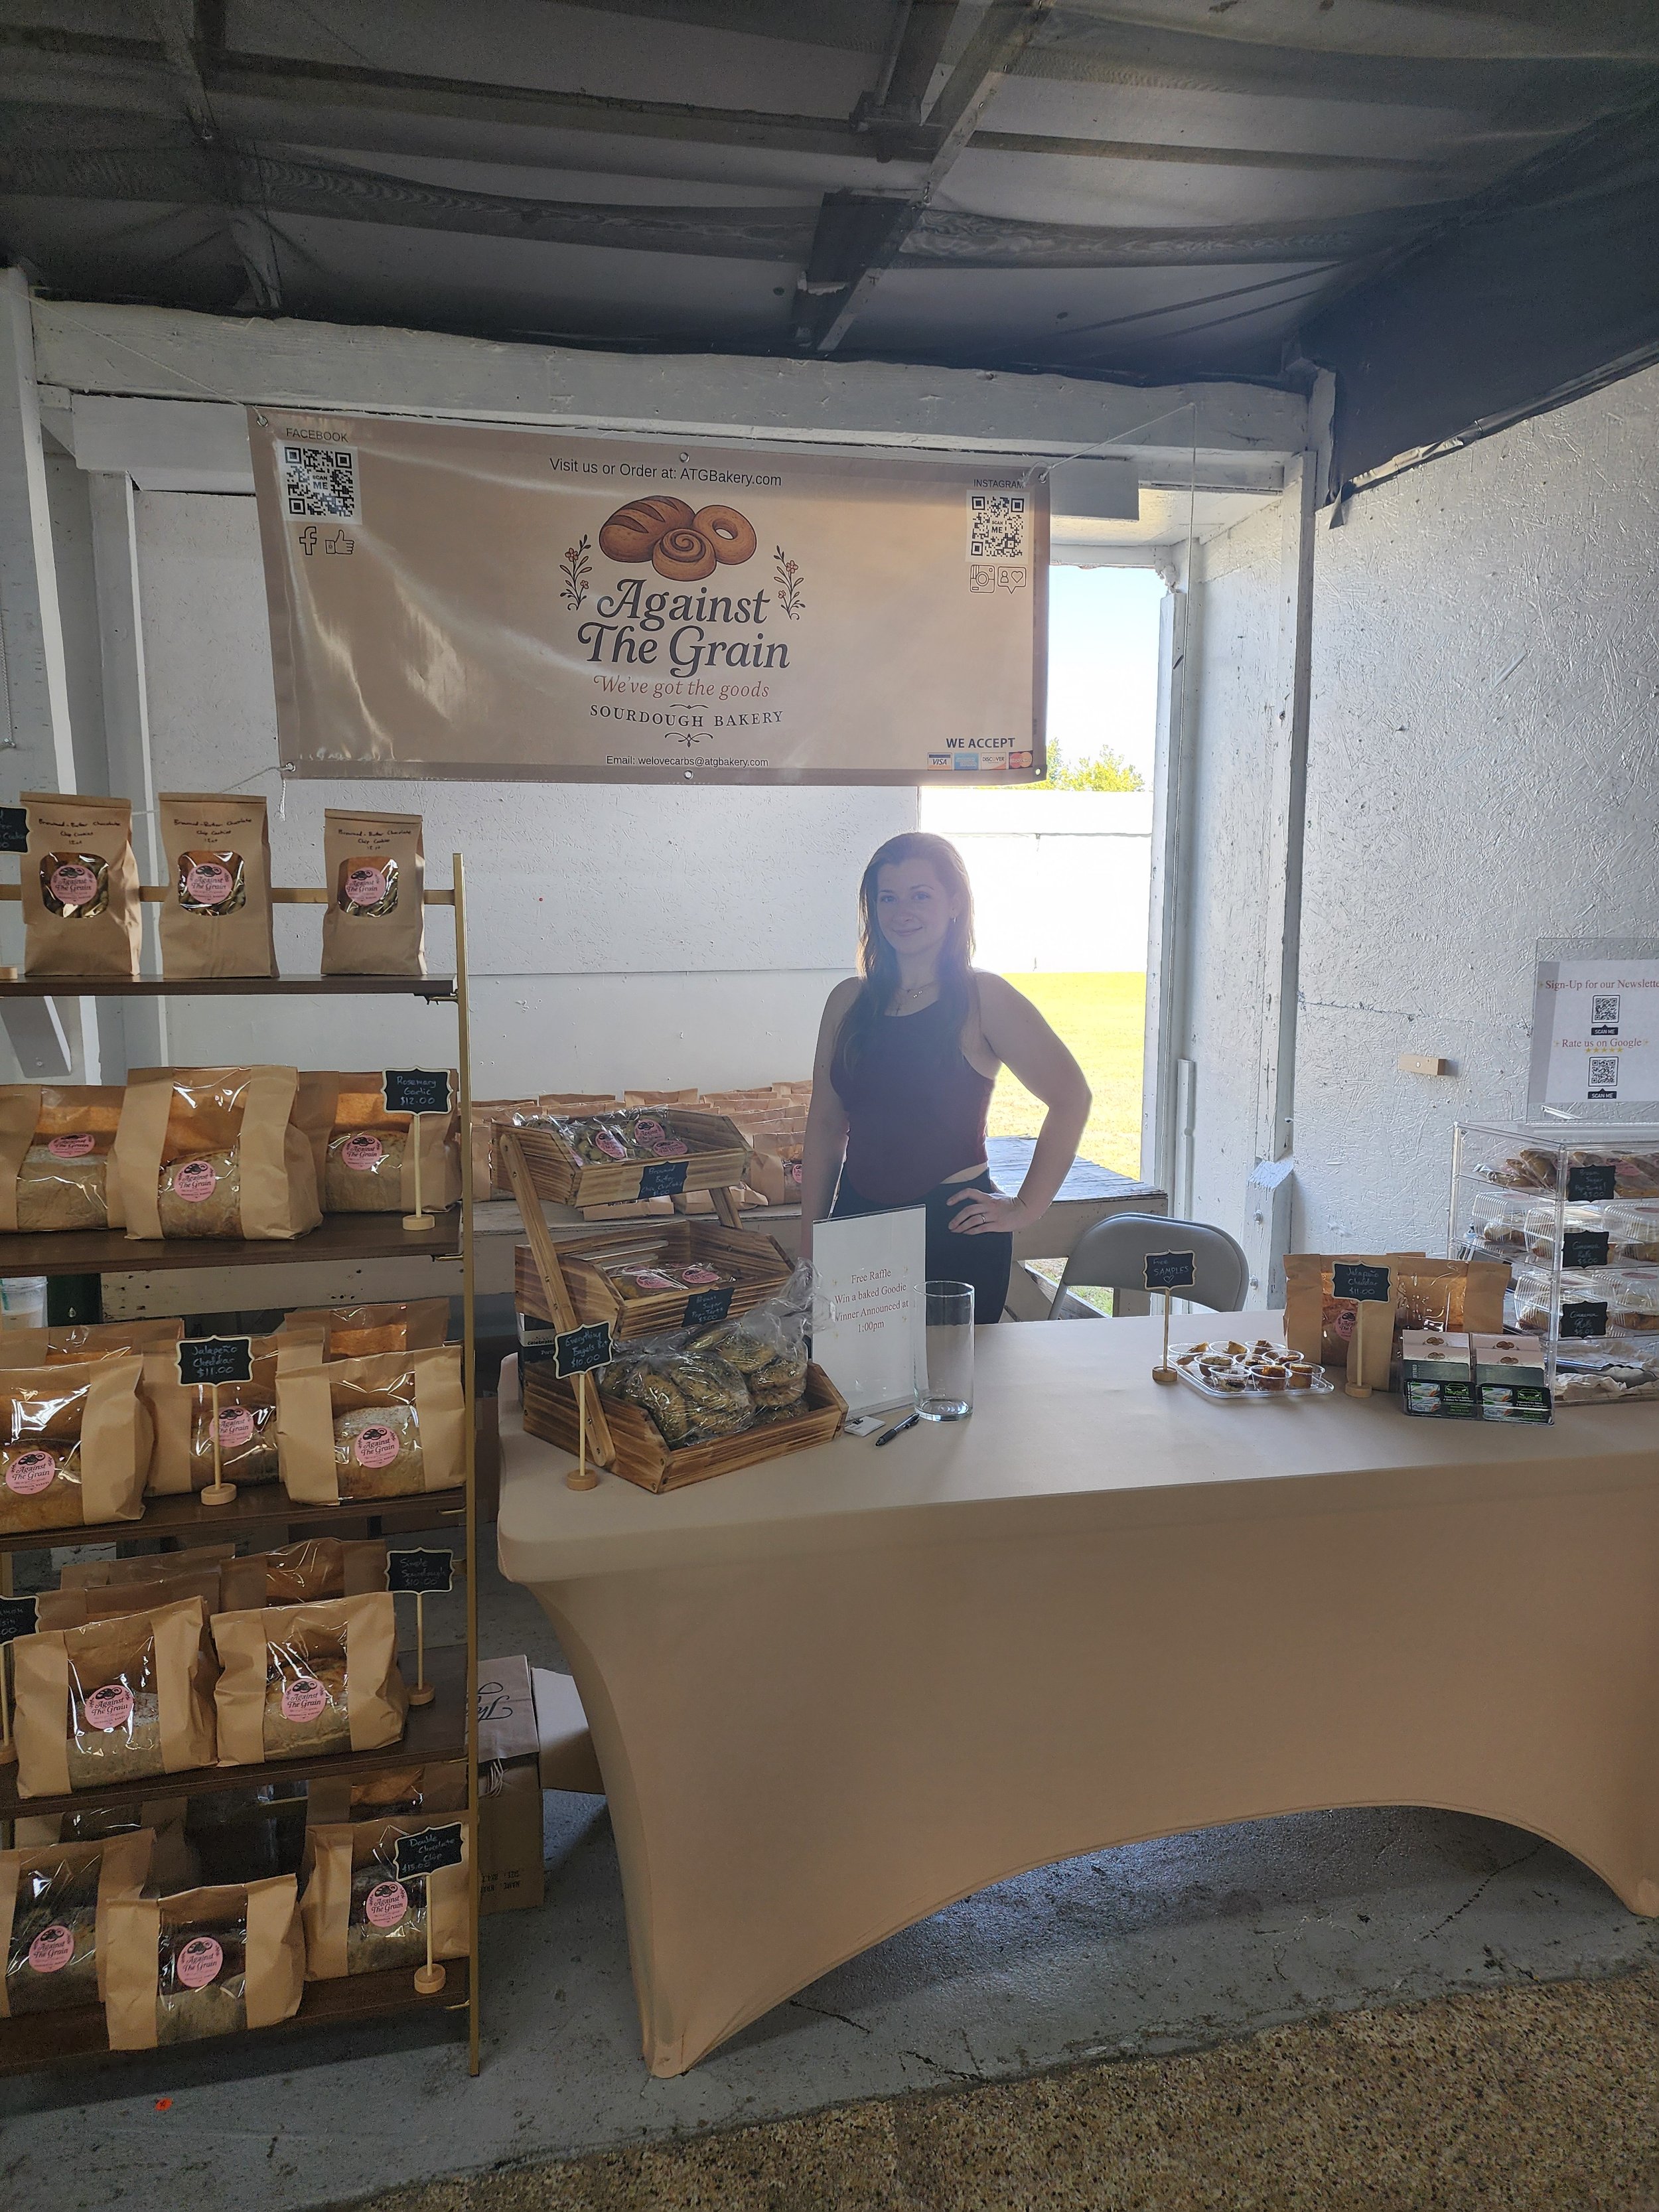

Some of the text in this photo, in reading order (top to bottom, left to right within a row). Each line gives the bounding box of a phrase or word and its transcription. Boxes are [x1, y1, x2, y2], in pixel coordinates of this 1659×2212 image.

[286, 427, 349, 443] FACEBOOK
[549, 457, 782, 486] Visit us or Order at: ATGBakery.com
[974, 479, 1024, 489] INSTAGRAM
[597, 578, 771, 631] Against
[577, 621, 790, 678] The Grain
[593, 674, 770, 701] We've got the goods
[590, 704, 784, 727] SOURDOUGH BAKERY
[946, 737, 1015, 749] WE ACCEPT
[606, 755, 769, 769] Email: welovecarbs@atgbakery.com
[1545, 980, 1582, 991] Sign-Up
[1617, 979, 1659, 988] Newslette
[1562, 1039, 1583, 1047] Rate
[1610, 1038, 1642, 1049] Google
[396, 1076, 437, 1088] Rosemary
[403, 1086, 431, 1095] Garlic
[400, 1096, 435, 1106] $12.00
[192, 1180, 211, 1189] Grain
[851, 1268, 891, 1284] Free Raffle
[1153, 1266, 1189, 1276] SAMPLES
[834, 1293, 850, 1304] Win
[858, 1288, 879, 1300] baked
[881, 1283, 906, 1295] Goodie
[860, 1300, 901, 1317] Announced
[858, 1321, 885, 1333] 1:00pm
[565, 1330, 602, 1347] Everything
[192, 1345, 238, 1355] Jalapeño
[572, 1343, 595, 1357] Bagels
[193, 1355, 235, 1367] Cheddar
[571, 1354, 600, 1367] $10.00
[196, 1366, 234, 1378] $11.00
[220, 1419, 245, 1428] Against
[229, 1426, 249, 1434] Grain
[363, 1438, 390, 1449] Against
[375, 1444, 395, 1454] Grain
[15, 1463, 46, 1474] Against
[27, 1470, 50, 1481] Grain
[95, 1697, 124, 1709] Against
[291, 1692, 319, 1702] Against
[107, 1704, 128, 1715] Grain
[301, 1699, 321, 1709] Grain
[409, 1834, 437, 1847] Double
[418, 1838, 455, 1854] Chocolate
[374, 1895, 400, 1907] Against
[371, 1901, 403, 1914] The Grain
[47, 1948, 68, 1958] Grain
[196, 1960, 218, 1971] Grain
